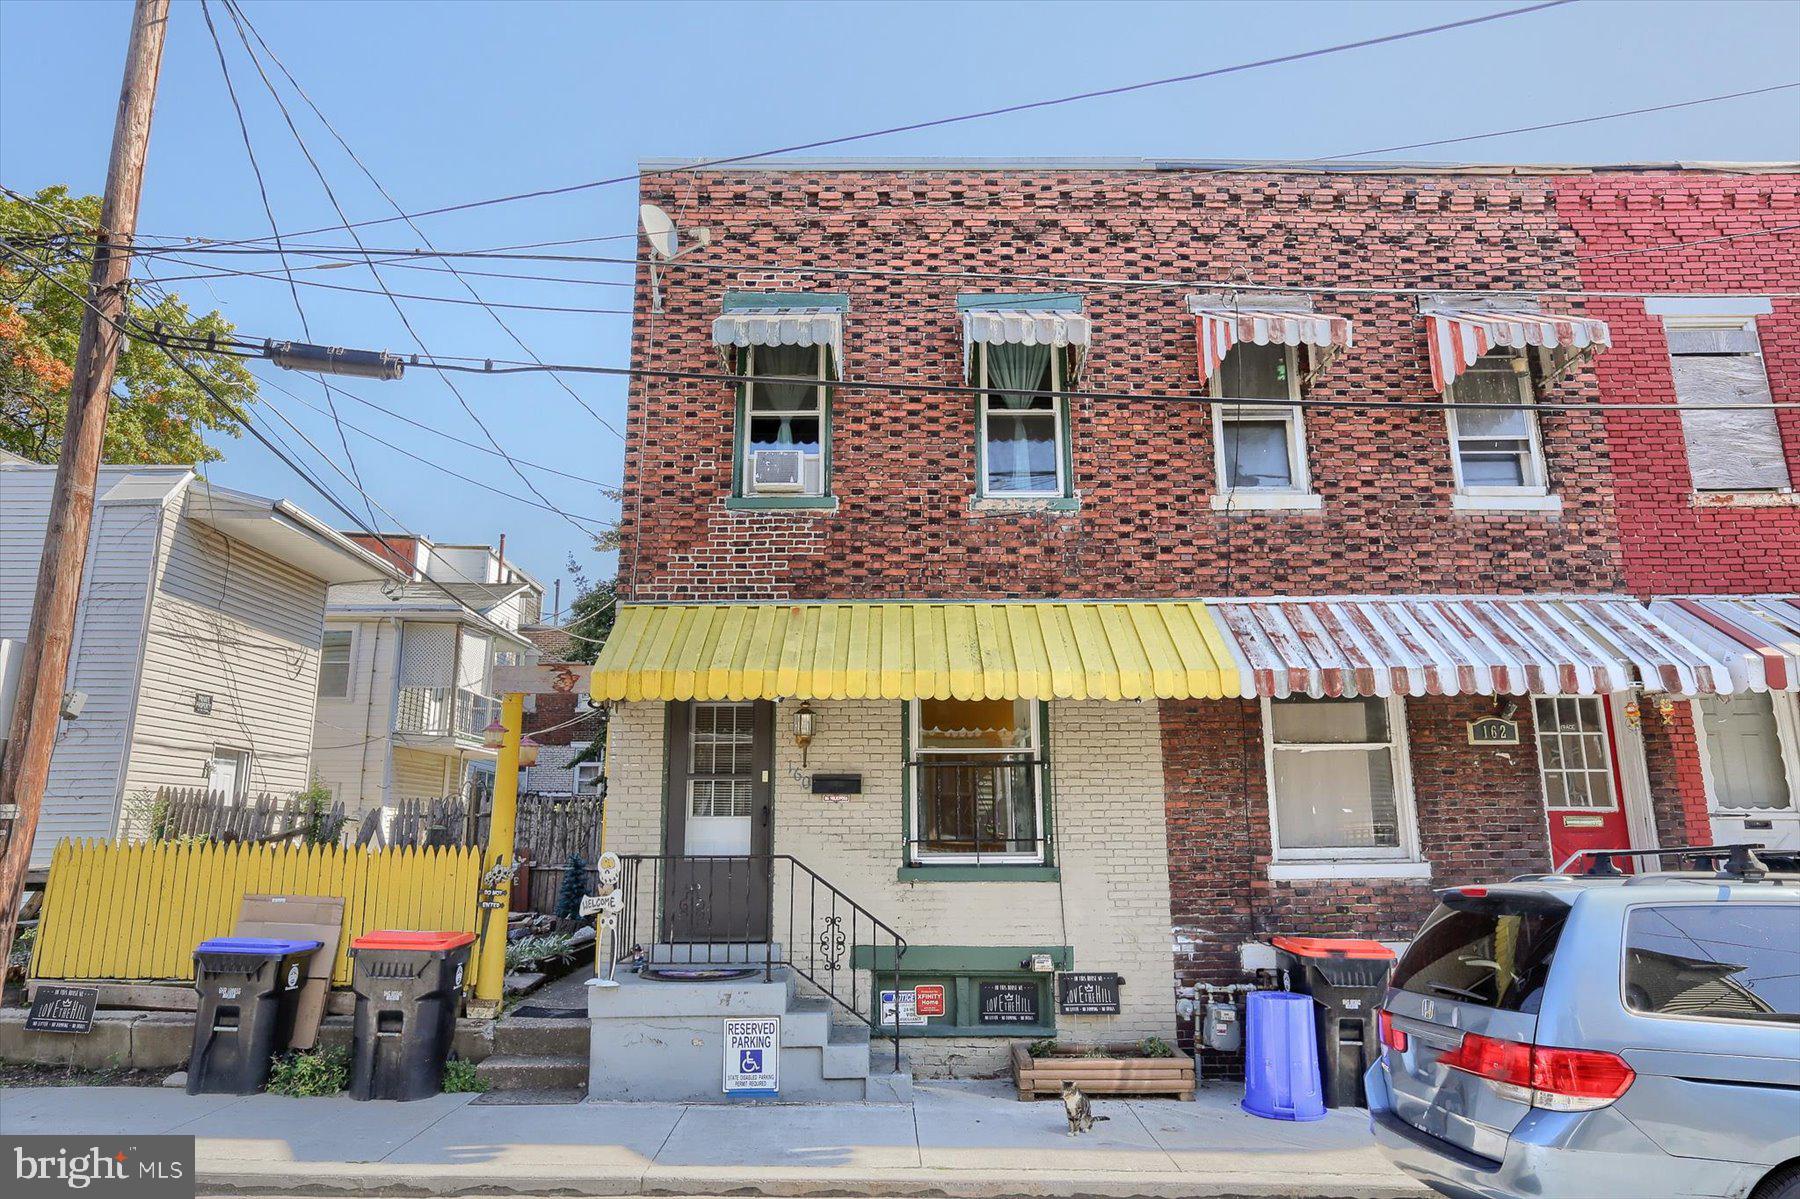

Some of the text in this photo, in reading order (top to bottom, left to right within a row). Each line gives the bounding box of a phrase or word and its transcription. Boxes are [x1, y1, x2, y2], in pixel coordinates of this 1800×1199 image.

[1483, 725, 1507, 739] 162
[788, 761, 811, 789] 160
[582, 897, 615, 910] WELCOME
[1084, 993, 1096, 1003] THE
[1095, 985, 1112, 1003] HILL
[38, 1000, 87, 1020] LOVE THE HILL
[986, 994, 1031, 1012] LOVE THE HILL
[728, 1023, 775, 1035] RESERVED
[731, 1036, 771, 1048] PARKING
